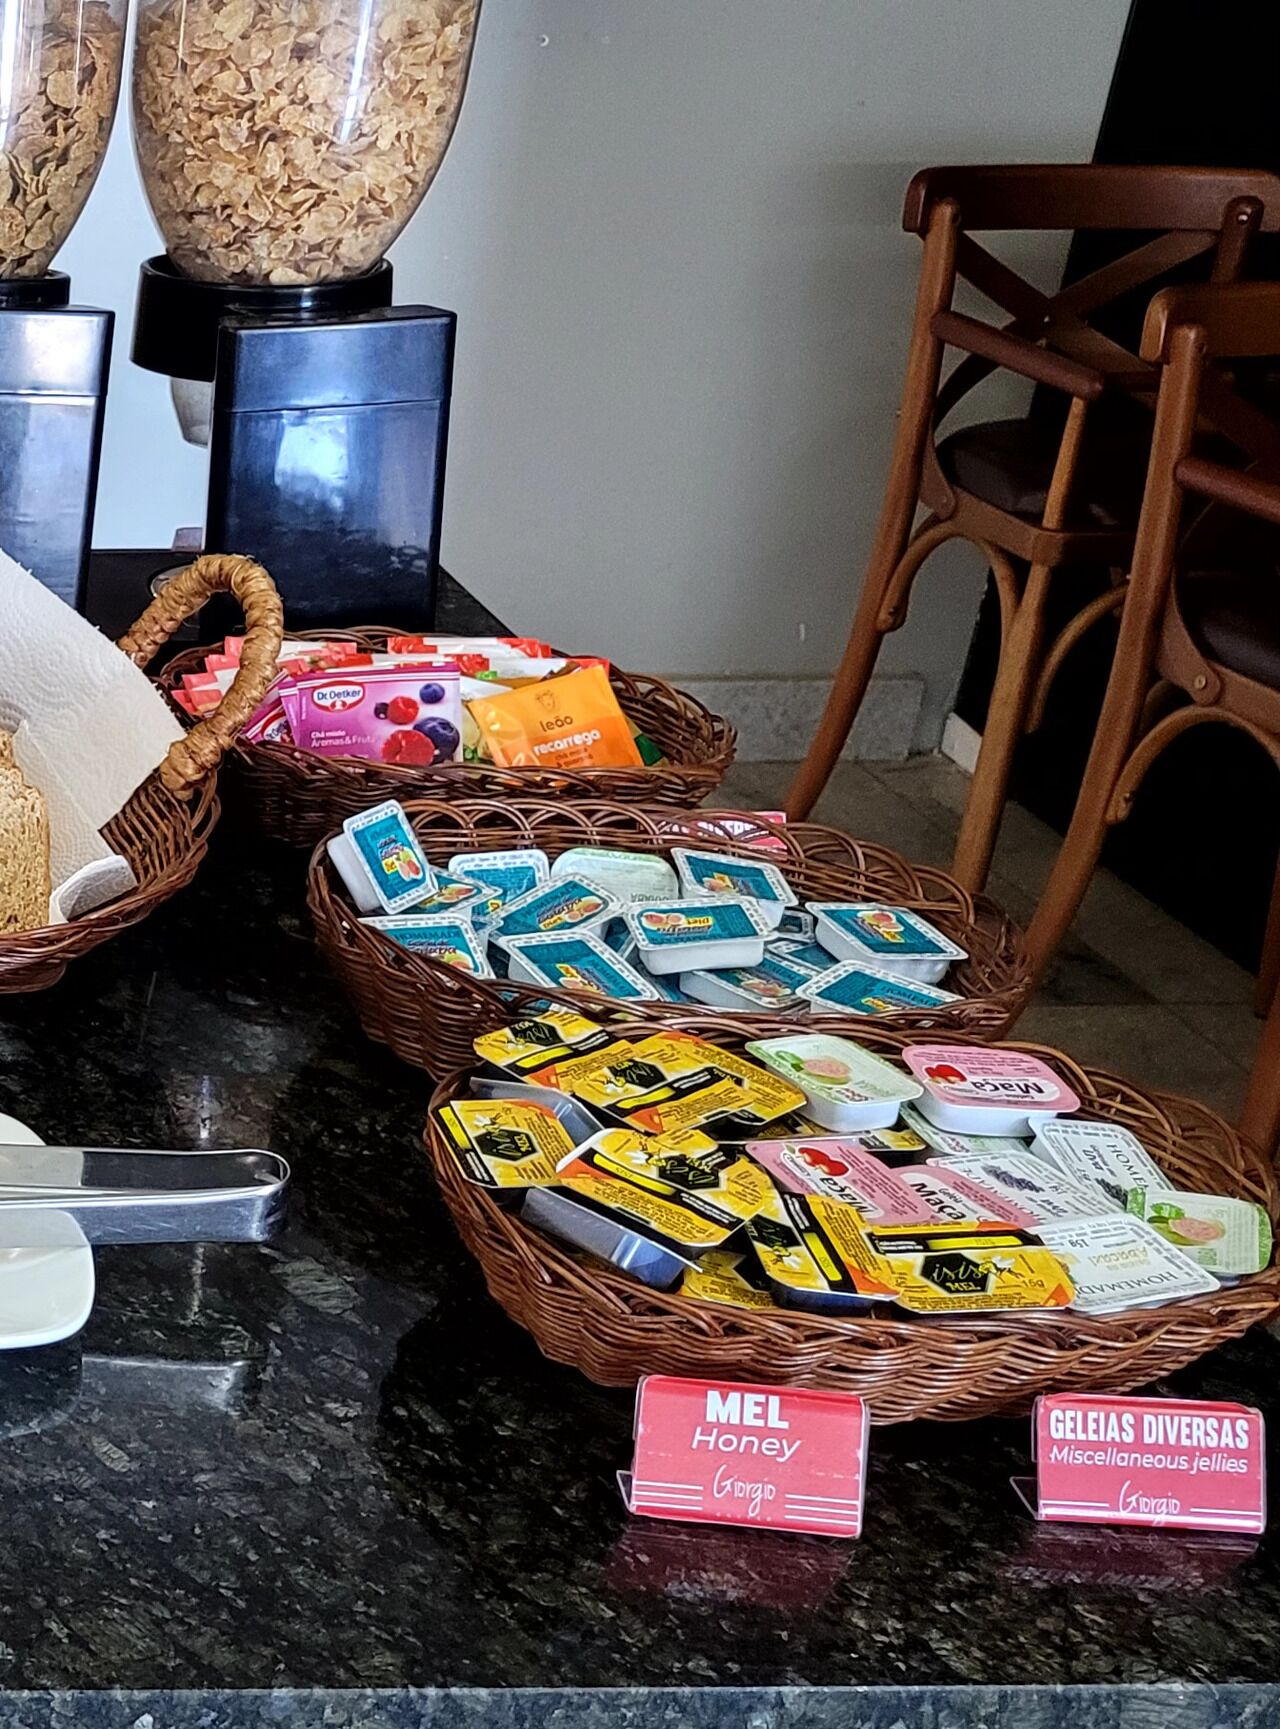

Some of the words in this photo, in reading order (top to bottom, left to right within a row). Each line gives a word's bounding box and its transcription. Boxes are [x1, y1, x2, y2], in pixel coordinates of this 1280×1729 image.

[540, 714, 574, 733] leão
[533, 729, 601, 757] recarrega
[932, 1260, 985, 1283] isis
[945, 1281, 982, 1293] MEL
[706, 1390, 789, 1429] MEL
[1050, 1409, 1135, 1444] GELEIAS
[1143, 1414, 1249, 1449] DIVERSAS
[691, 1427, 801, 1462] Honey
[1049, 1445, 1188, 1470] Miscellaneous
[1189, 1452, 1248, 1475] jellies
[713, 1464, 776, 1517] Giorgio
